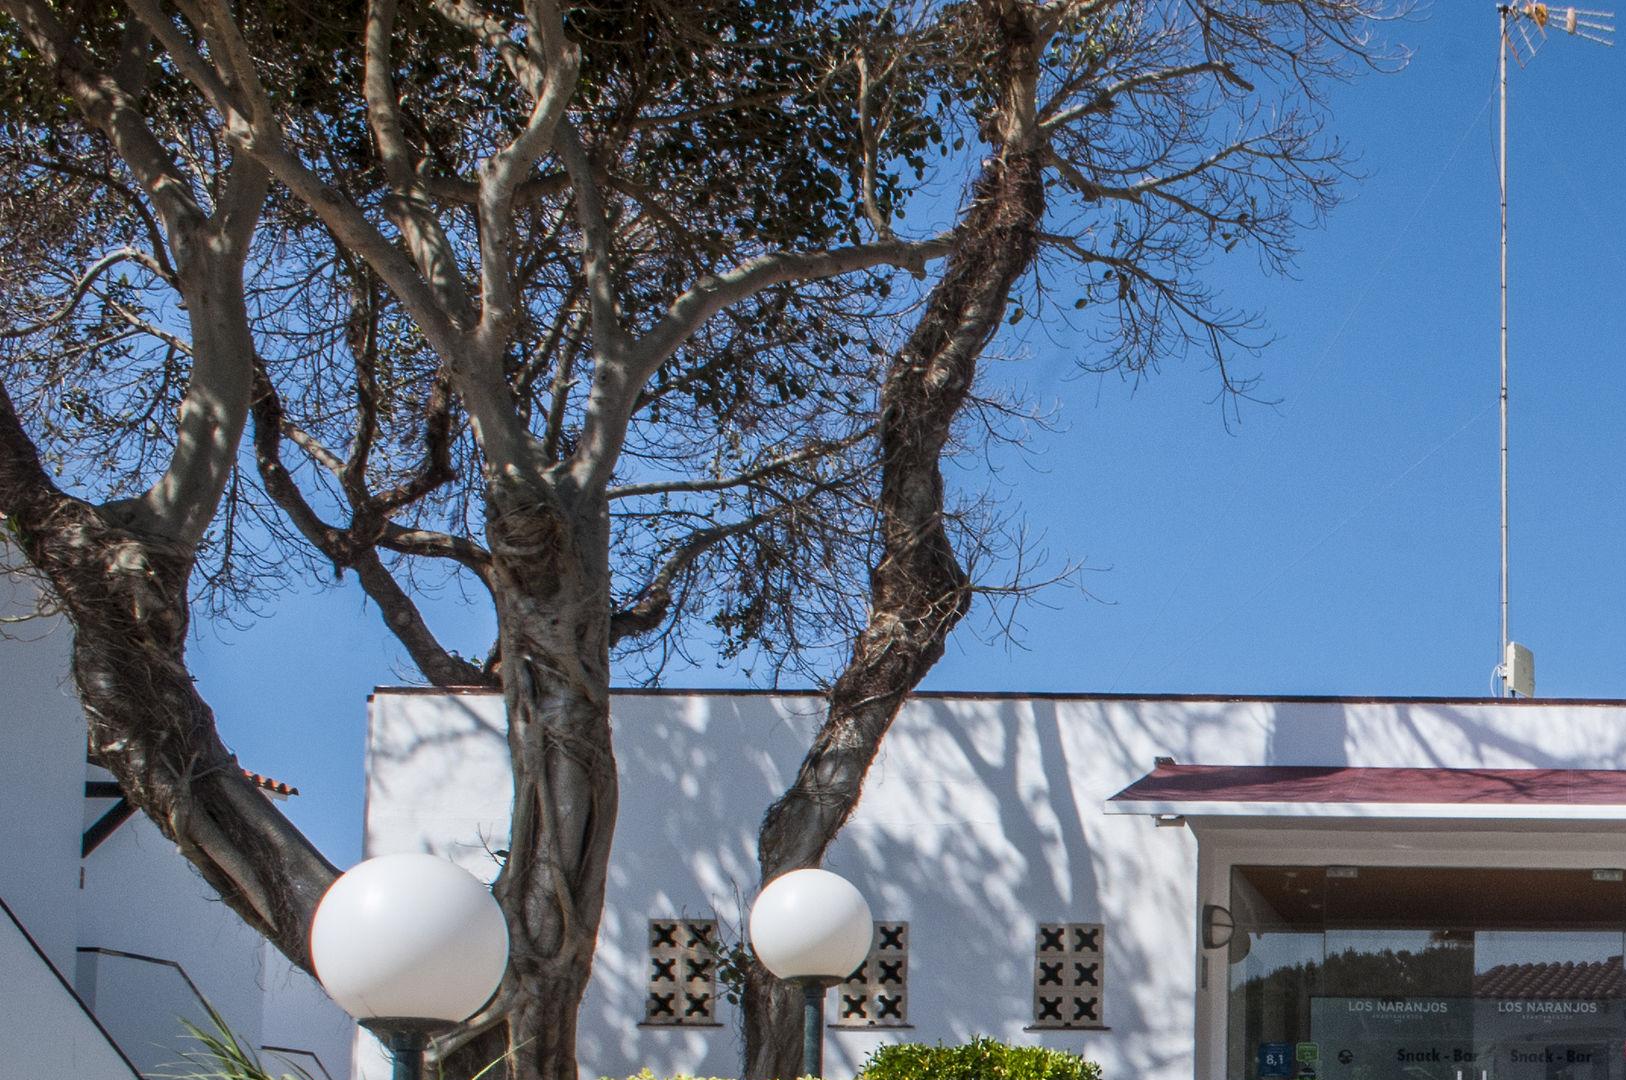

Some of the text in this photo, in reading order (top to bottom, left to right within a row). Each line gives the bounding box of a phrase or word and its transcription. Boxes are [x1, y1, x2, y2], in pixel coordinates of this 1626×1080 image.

[1348, 1001, 1448, 1013] LOS NARANJOS
[1498, 1002, 1598, 1013] LOS NARANJOS
[1397, 1048, 1441, 1063] Snack
[1453, 1048, 1480, 1063] Bar
[1510, 1048, 1553, 1064] Snack
[1566, 1049, 1592, 1064] Bar
